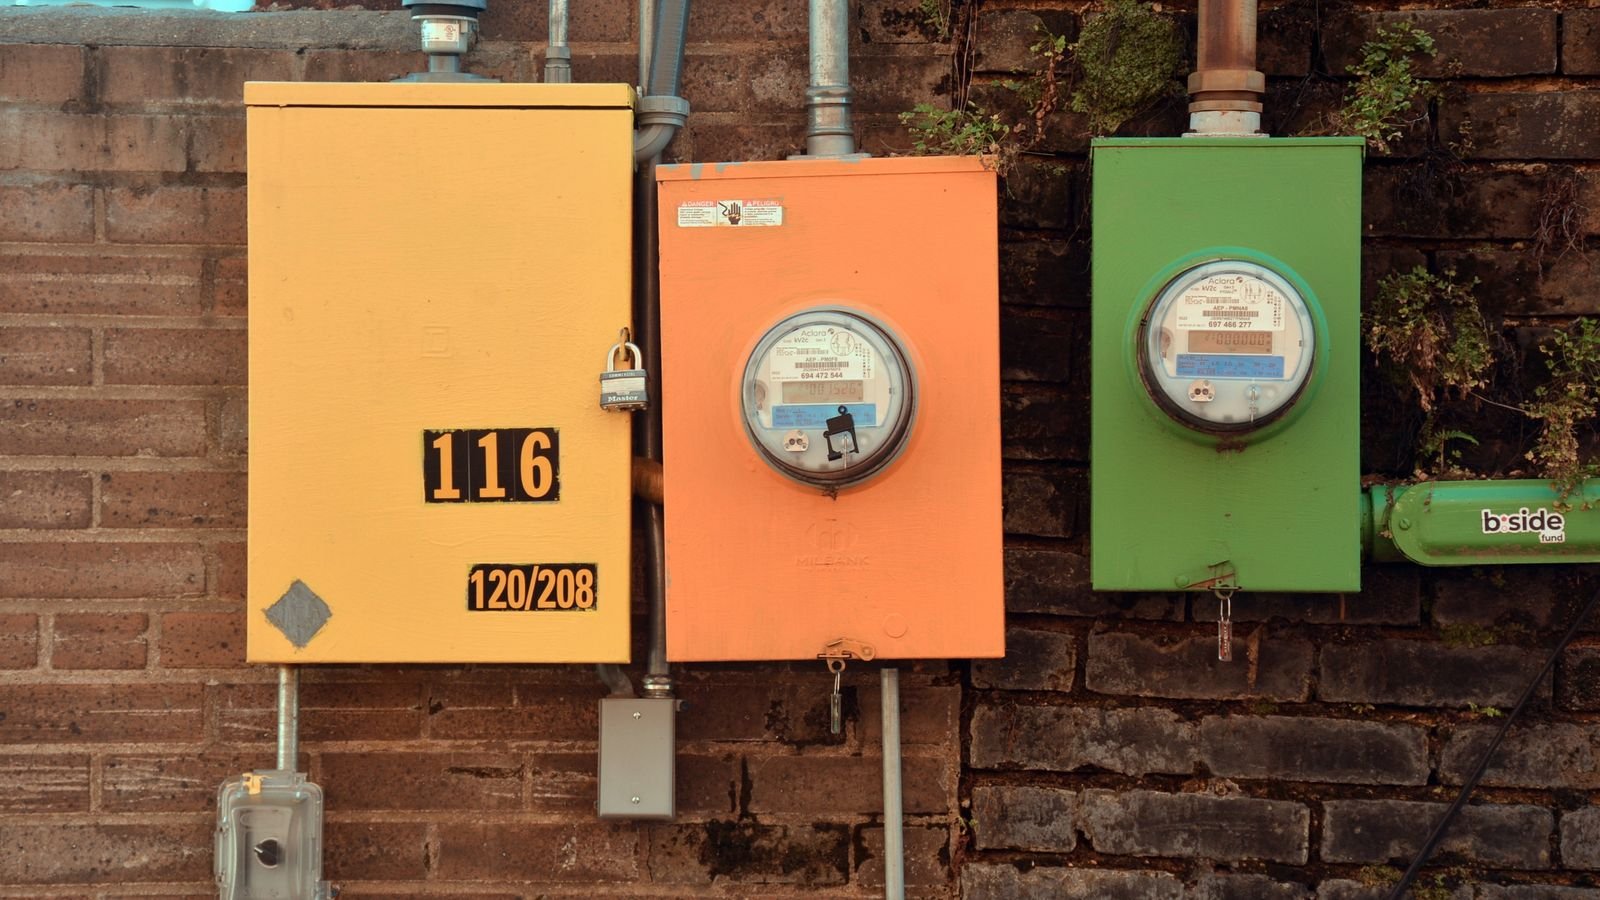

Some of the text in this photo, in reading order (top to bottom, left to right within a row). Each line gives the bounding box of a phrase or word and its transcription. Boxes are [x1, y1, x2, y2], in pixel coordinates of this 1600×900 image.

[1208, 277, 1235, 285] Aclara
[801, 329, 827, 337] Aclara
[432, 430, 553, 499] 116
[1541, 534, 1563, 542] fund
[470, 565, 594, 611] 120/208
